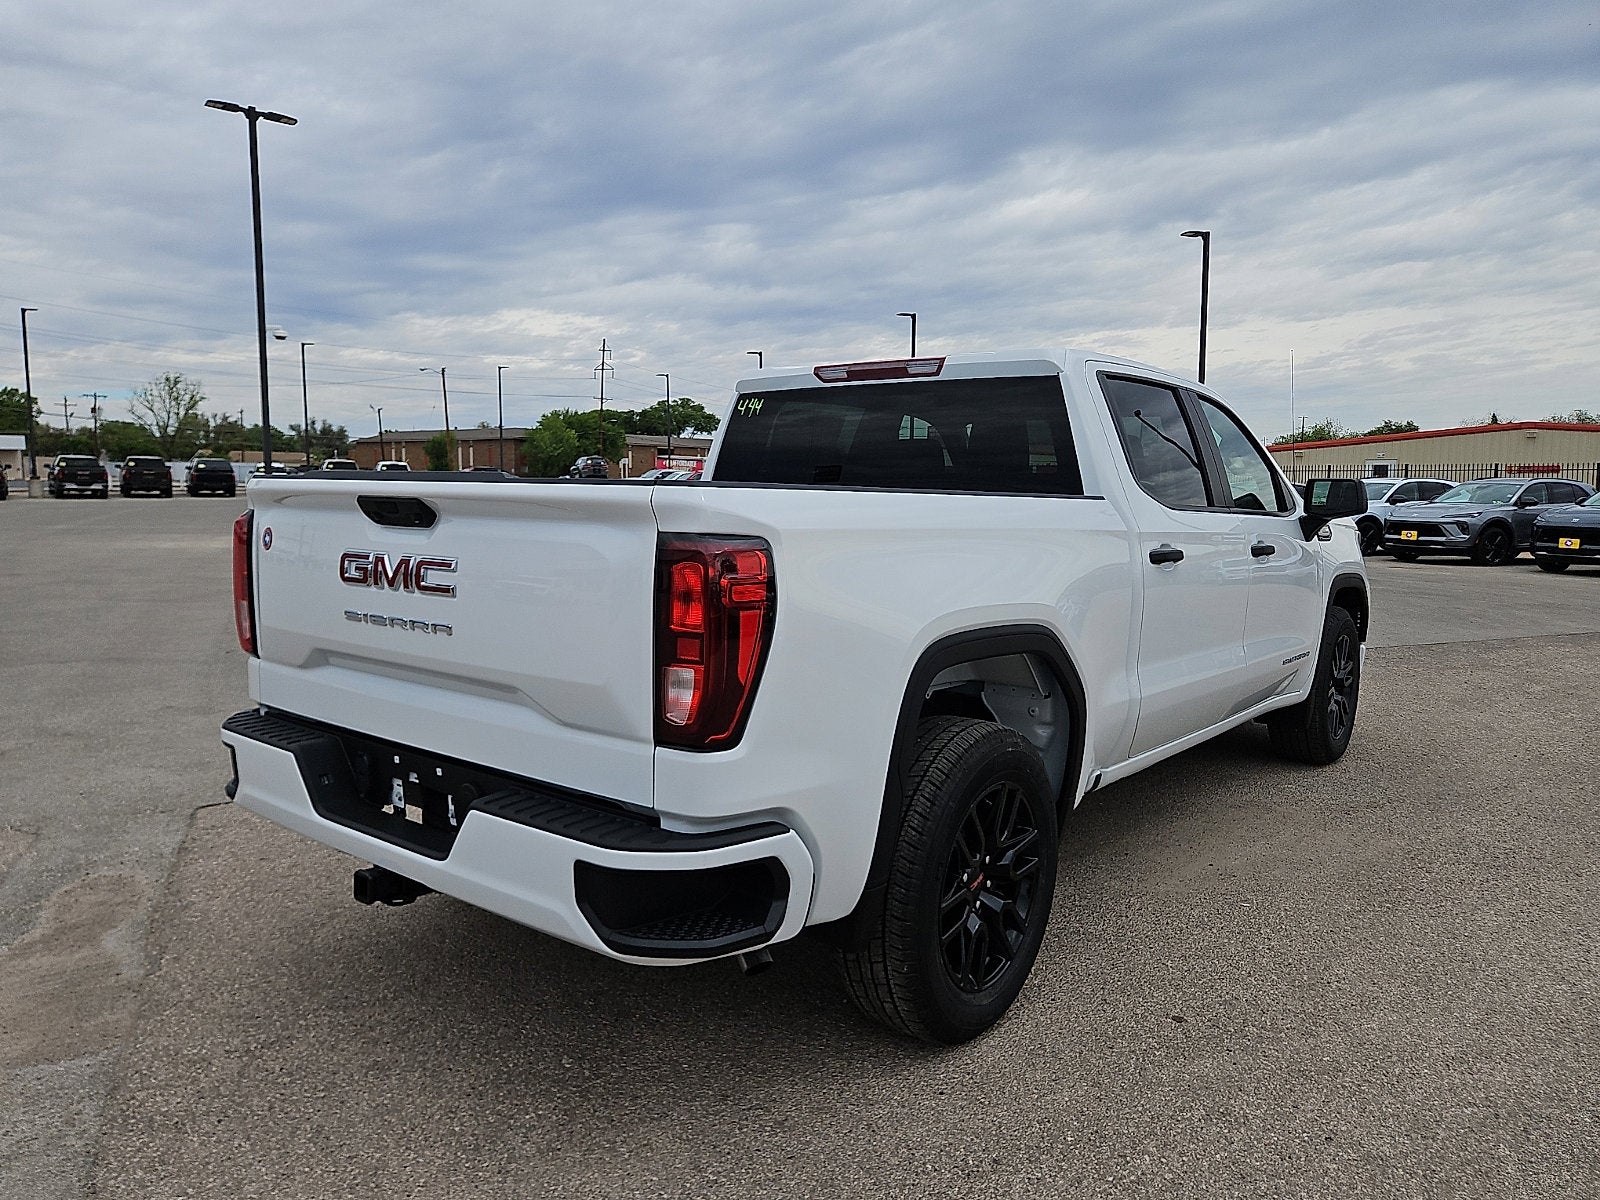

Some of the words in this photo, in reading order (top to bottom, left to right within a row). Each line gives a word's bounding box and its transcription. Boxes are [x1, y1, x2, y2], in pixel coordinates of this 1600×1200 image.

[737, 397, 765, 418] 444
[338, 548, 459, 599] GMC
[343, 609, 454, 637] SIERRA
